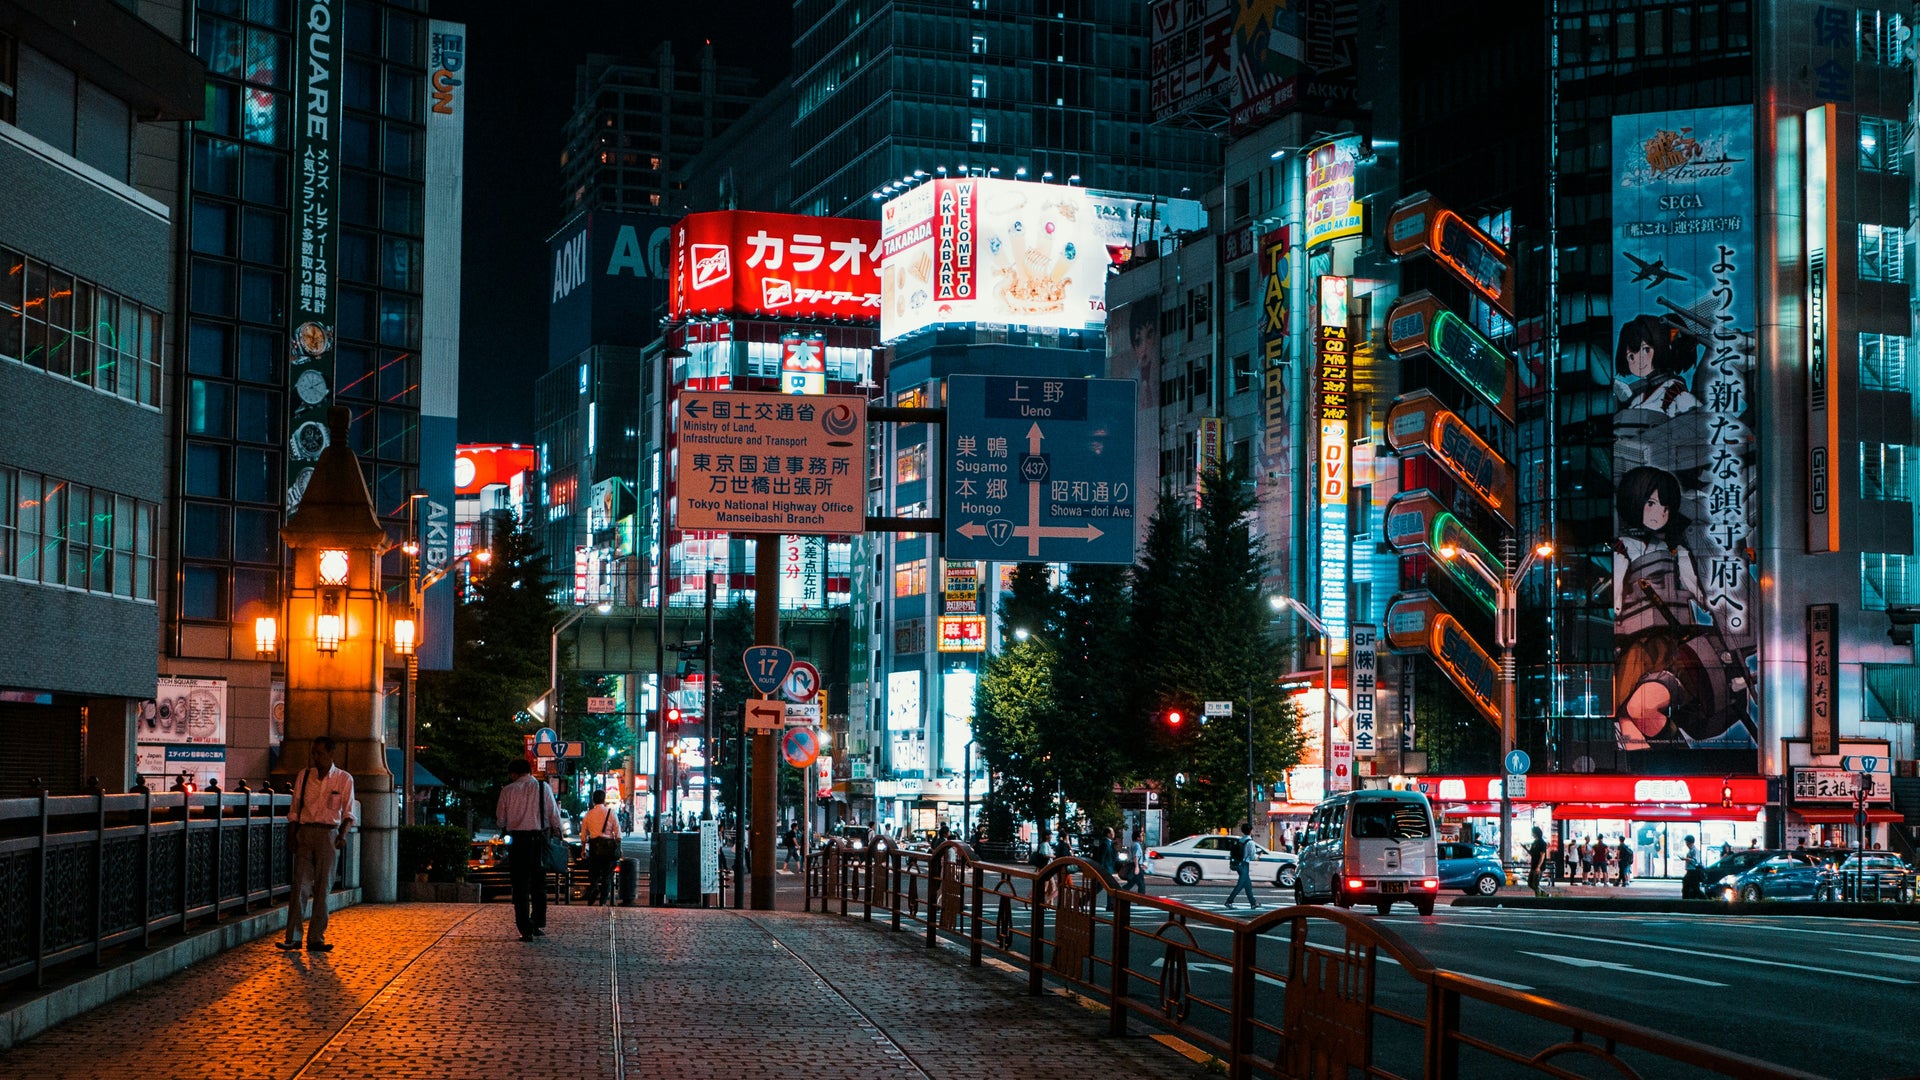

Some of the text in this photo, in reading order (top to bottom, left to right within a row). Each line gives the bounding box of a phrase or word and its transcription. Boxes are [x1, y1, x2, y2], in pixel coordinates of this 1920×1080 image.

[306, 0, 332, 141] QUARE
[1657, 163, 1731, 180] Arcade
[1660, 195, 1702, 210] SEGA
[1334, 216, 1361, 228] AKIBA
[885, 221, 933, 256] TAKARADA
[940, 191, 953, 297] AKIHABARA
[958, 184, 971, 296] WELCOME TO
[553, 229, 588, 304] AOKI
[1265, 243, 1283, 334] TAX
[1089, 301, 1108, 311] TA
[1323, 328, 1345, 338] ゲーム
[1392, 312, 1424, 343] SEGA
[1325, 340, 1344, 351] CD
[787, 341, 821, 370] 本
[1323, 354, 1346, 365] アイドル
[1323, 367, 1346, 378] アニメ
[1008, 380, 1064, 403] 上野
[1323, 381, 1345, 391] コミック
[1266, 338, 1282, 456] FREE
[1324, 394, 1344, 404] ホビー
[713, 401, 816, 422] 国土交通省
[1021, 405, 1052, 417] Ueno
[684, 421, 718, 434] Ministry
[722, 423, 730, 432] of
[1709, 244, 1743, 628] ようこそ新たな鎮守府へ。
[684, 434, 808, 449] Infrastructure and Transport
[956, 435, 1008, 458] 巣鴨
[693, 454, 851, 476] 東京国道事務所
[956, 459, 1008, 475] Sugamo
[1025, 462, 1048, 475] 437
[1443, 423, 1494, 498] SEGA
[1325, 444, 1342, 496] DVD
[709, 475, 833, 496] 万世橋出張所
[955, 478, 1008, 500] 本郷
[1813, 449, 1825, 512] GIGO
[1051, 480, 1129, 503] 昭和通り
[688, 499, 854, 513] Tokyo National Highway Office
[961, 502, 1002, 517] Hongo
[1113, 506, 1133, 518] Ave.
[716, 512, 825, 525] Manseibashi Branch
[1393, 511, 1425, 537] SEGA
[991, 523, 1009, 539] 17
[1355, 633, 1375, 646] 8F
[758, 658, 779, 676] 17
[1444, 628, 1494, 708] SEGA
[759, 677, 776, 685] ROUTE
[1355, 650, 1375, 751] (株)半田保全
[554, 743, 566, 754] 17
[1864, 757, 1877, 769] 17
[1636, 781, 1690, 800] SEGA
